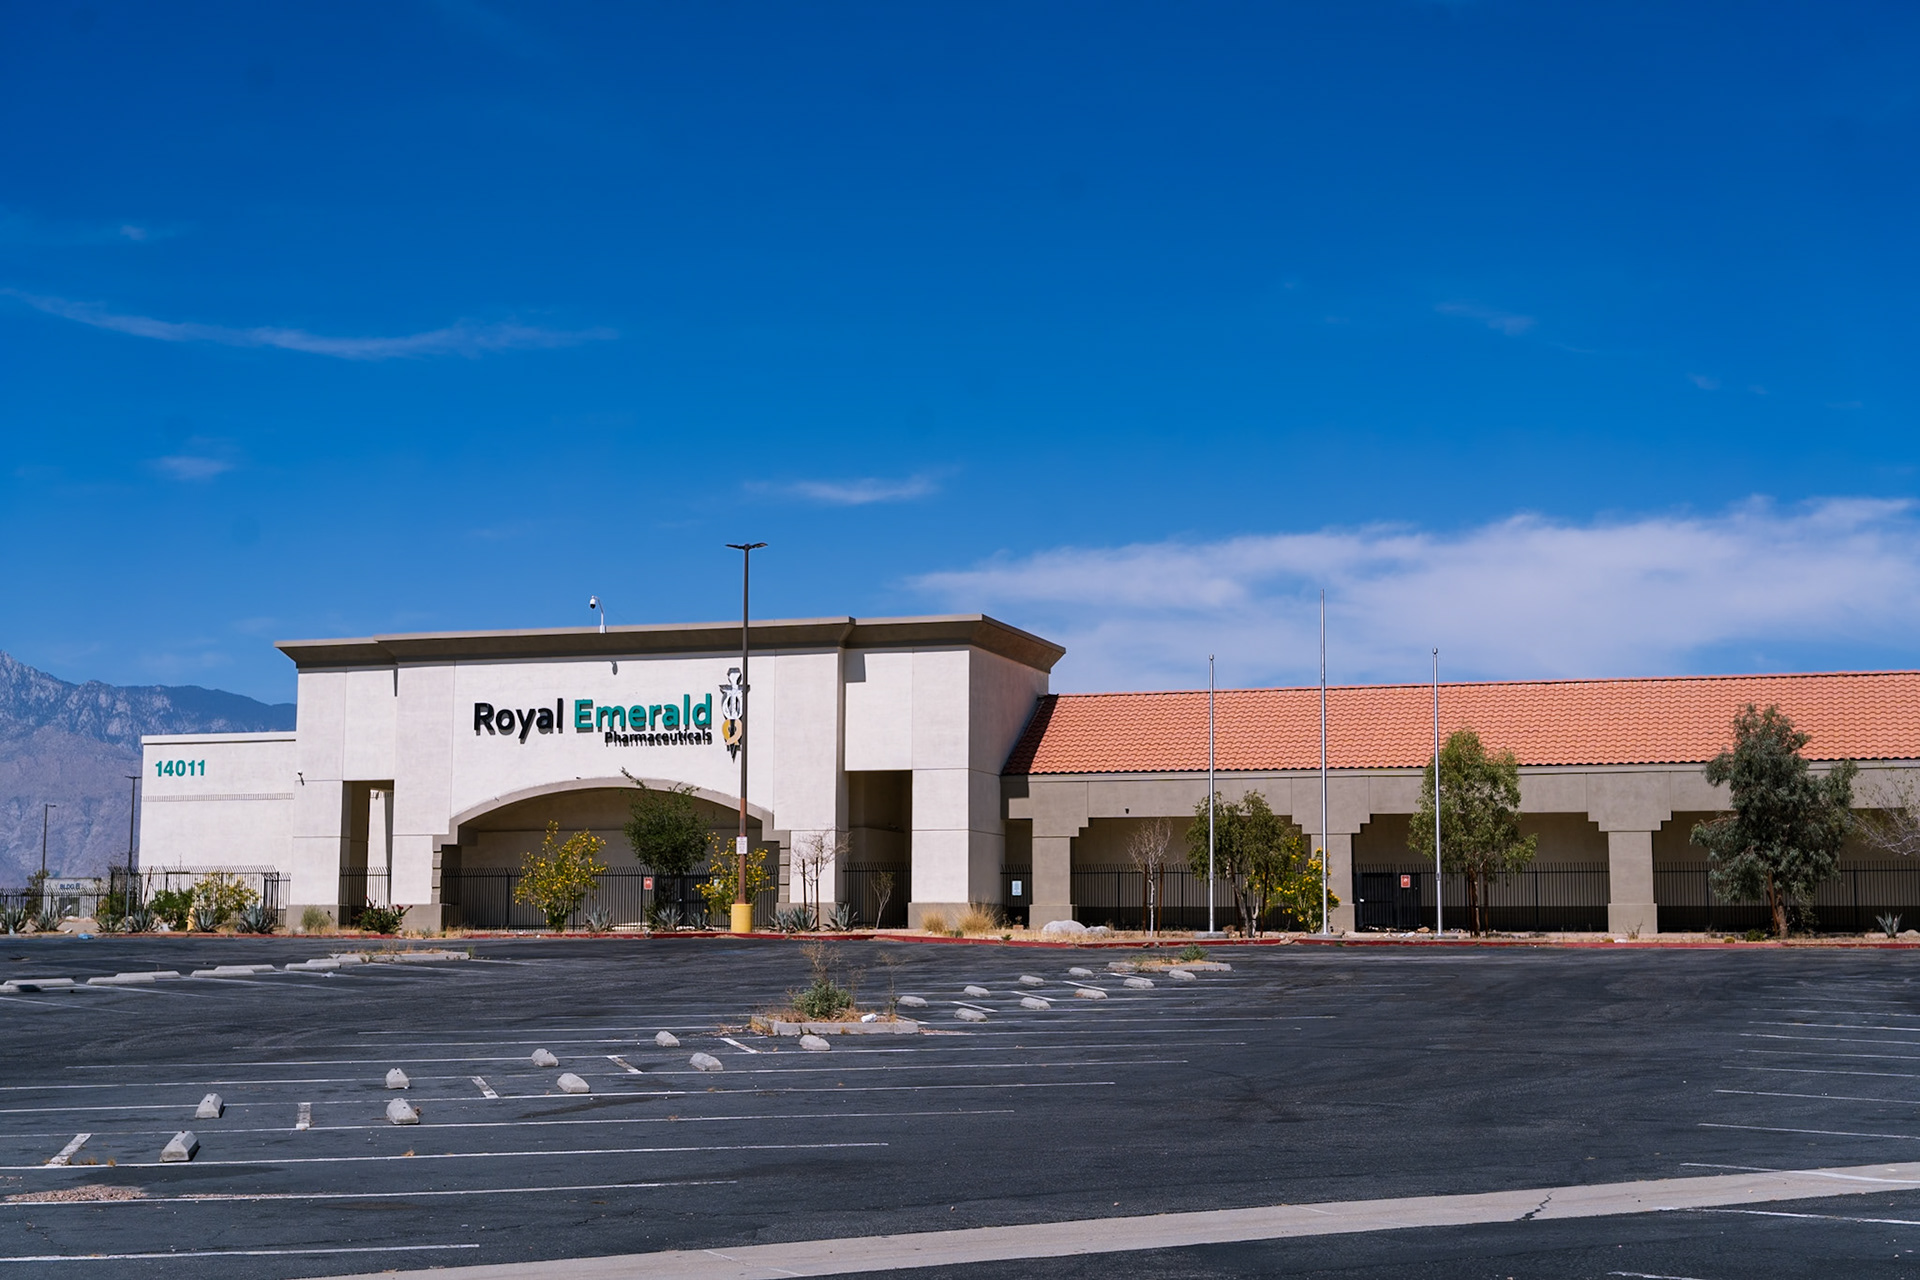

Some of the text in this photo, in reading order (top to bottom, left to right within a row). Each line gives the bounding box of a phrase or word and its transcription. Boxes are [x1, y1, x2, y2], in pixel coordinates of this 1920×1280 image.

[474, 692, 712, 740] Royal Emerald
[605, 729, 712, 744] Pharmaceuticals
[155, 759, 206, 778] 14011
